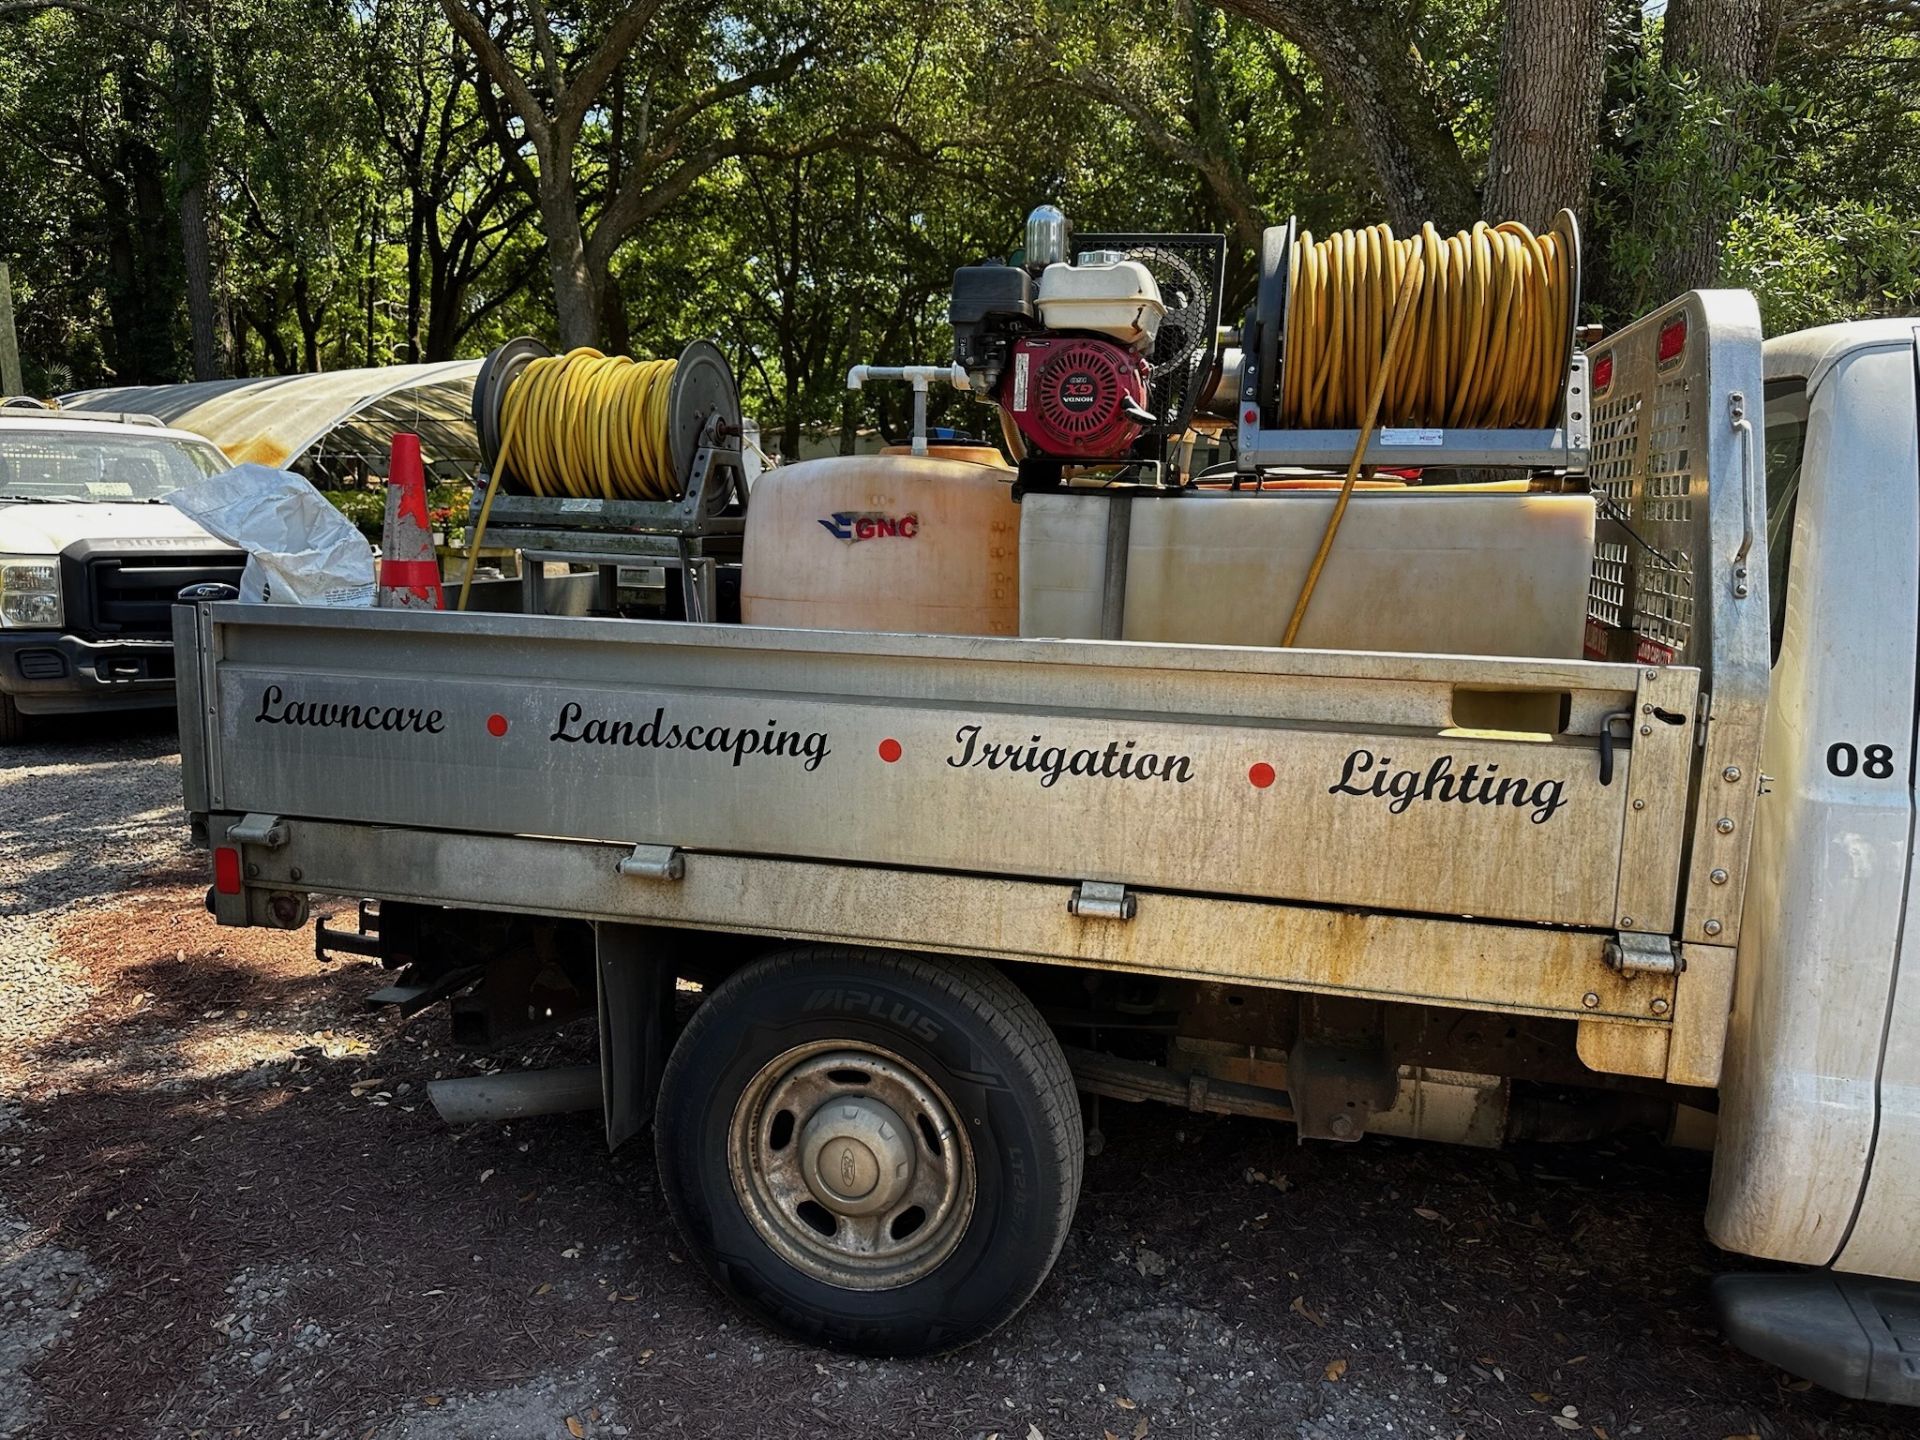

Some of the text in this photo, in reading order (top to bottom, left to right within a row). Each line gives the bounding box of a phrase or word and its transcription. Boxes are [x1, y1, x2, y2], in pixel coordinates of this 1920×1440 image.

[1064, 383, 1094, 396] GX
[255, 685, 1568, 825] Lawncare Landscaping Irrigation Lighting
[1826, 742, 1894, 779] 08
